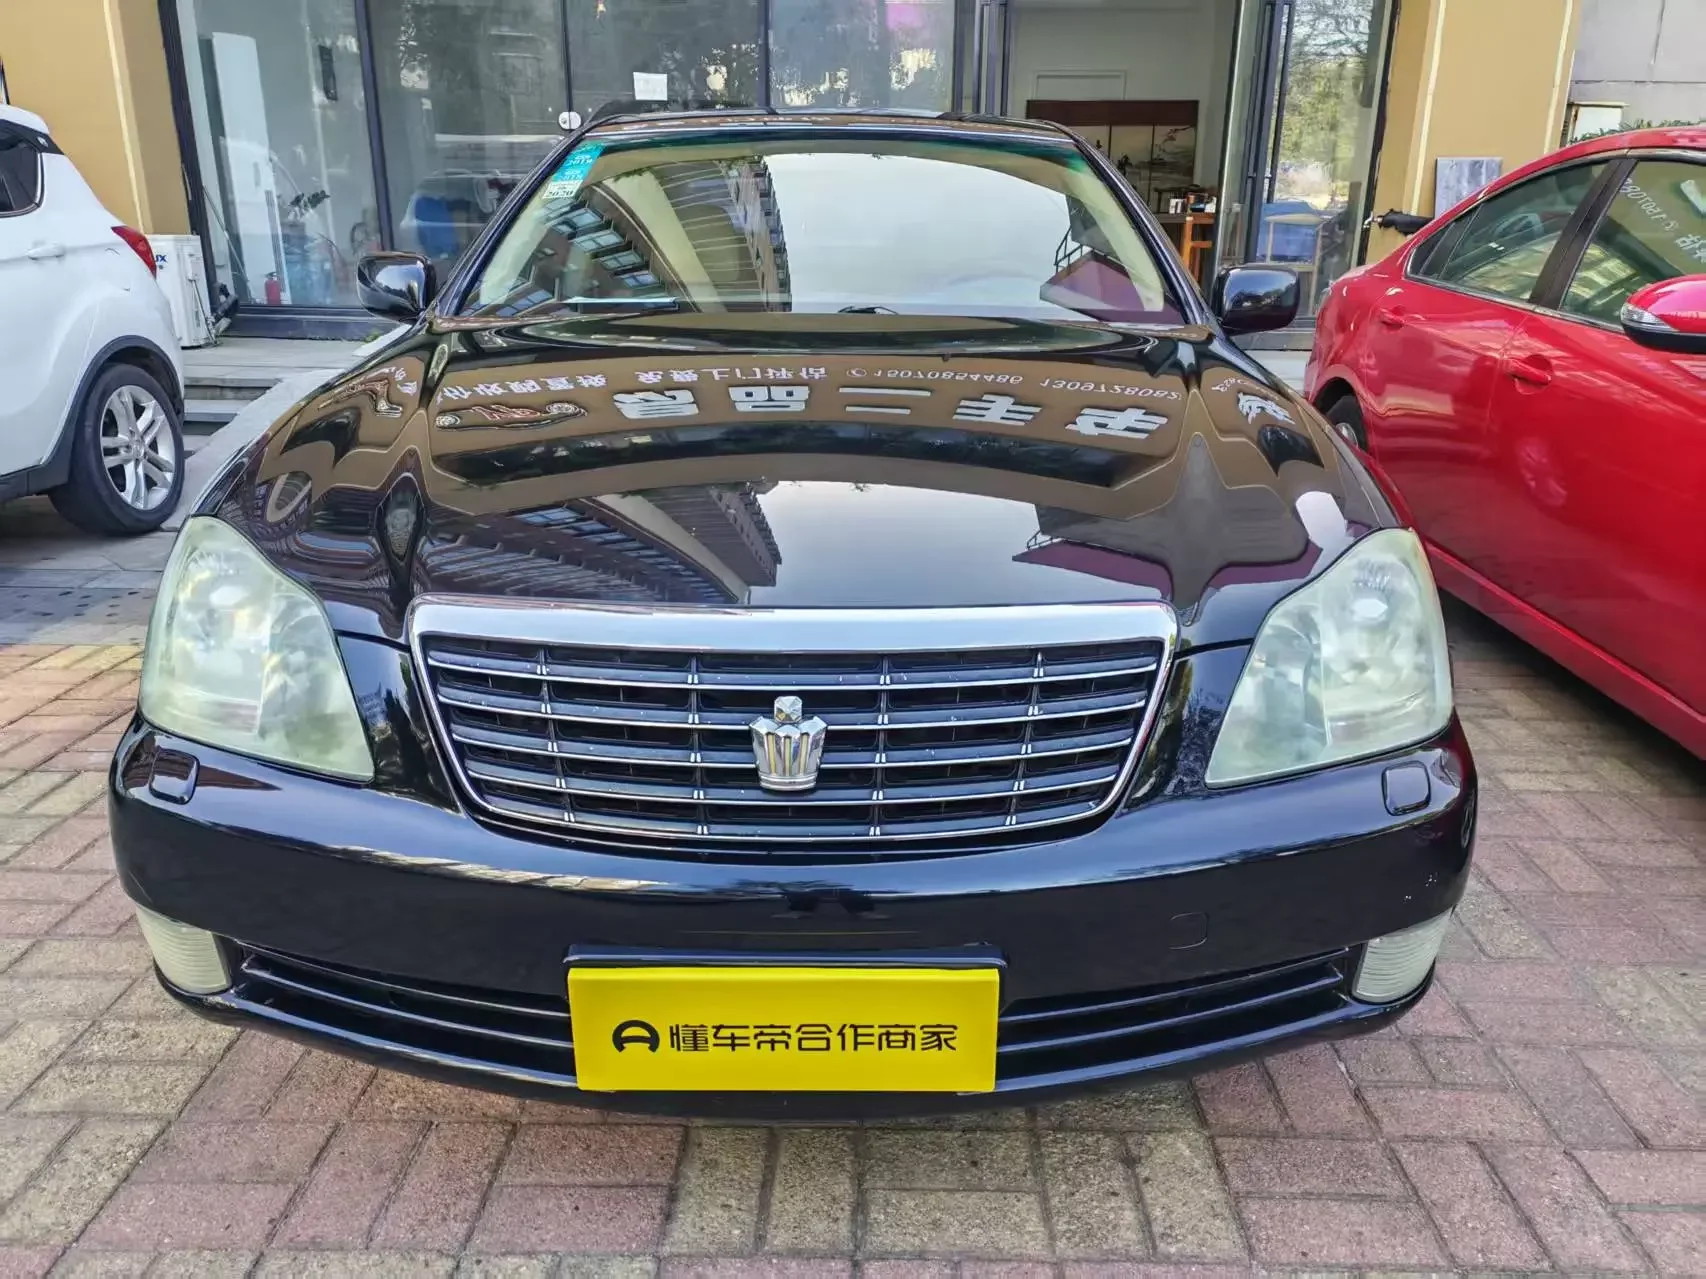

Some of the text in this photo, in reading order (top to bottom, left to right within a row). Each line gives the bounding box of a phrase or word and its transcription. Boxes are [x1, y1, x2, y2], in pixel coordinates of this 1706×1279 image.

[668, 1023, 959, 1052] 懂车帝合作商家
